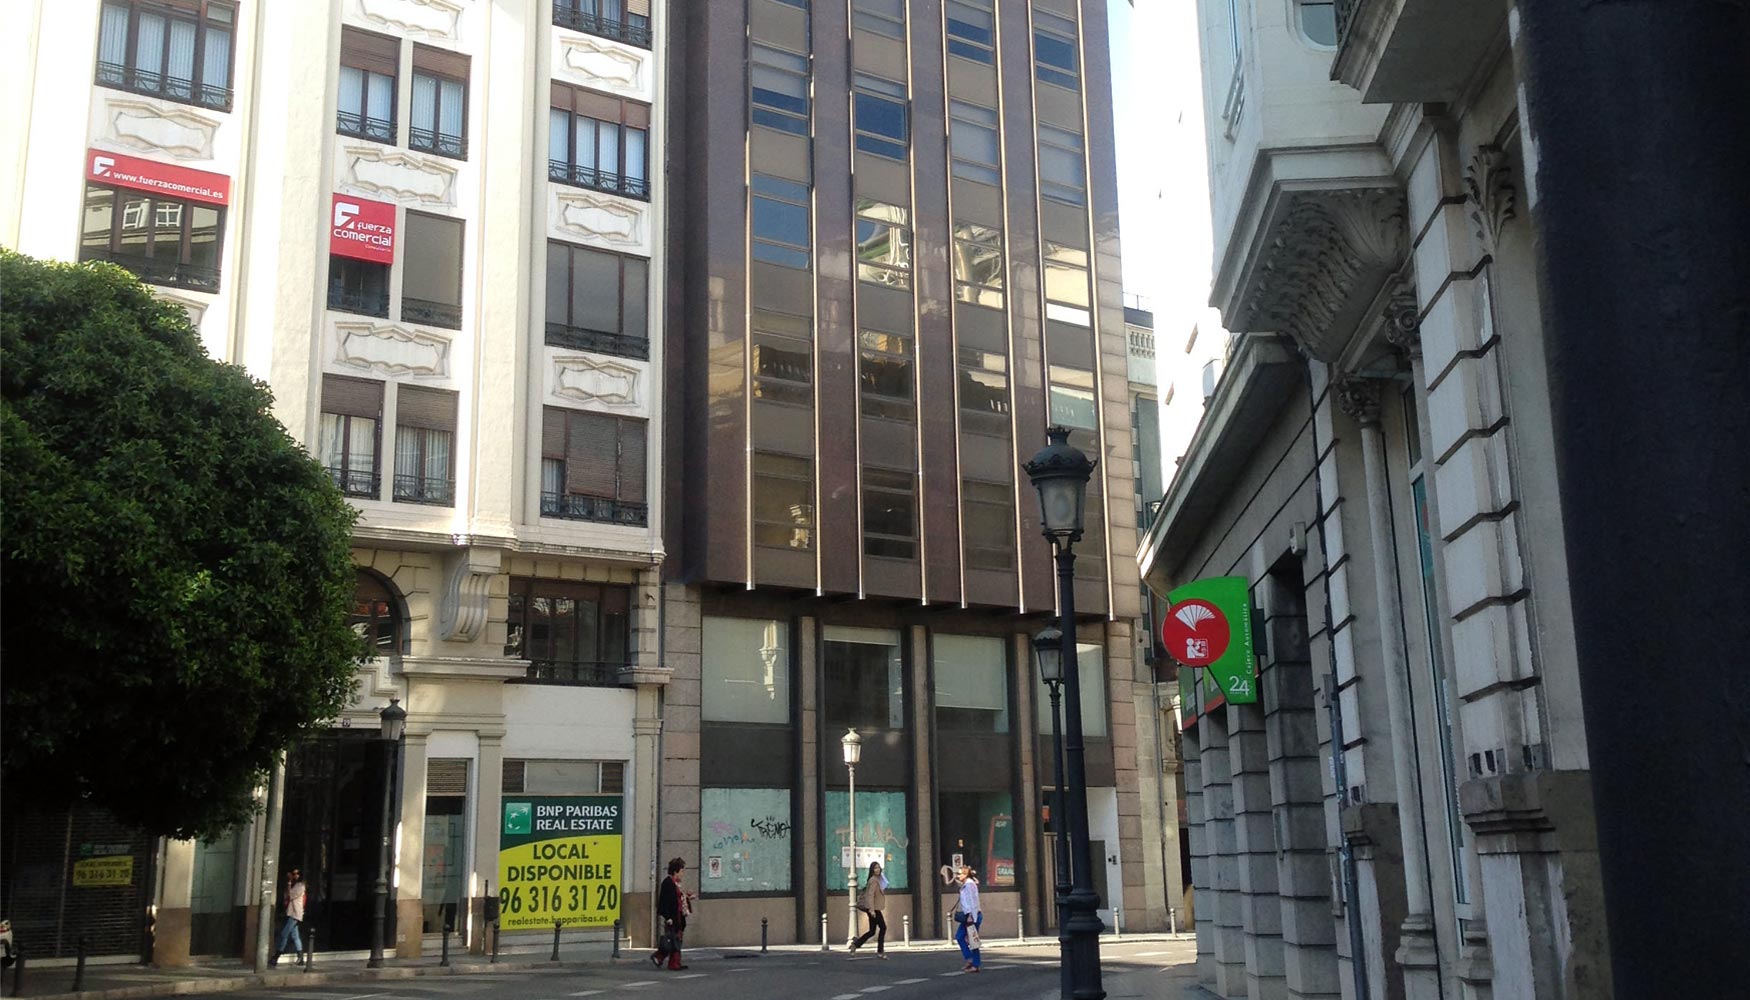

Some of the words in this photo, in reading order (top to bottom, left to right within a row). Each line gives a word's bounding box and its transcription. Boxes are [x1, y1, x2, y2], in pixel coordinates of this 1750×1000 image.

[113, 171, 223, 199] www.fuerzacomercial.es
[357, 222, 392, 234] fuerza
[333, 228, 392, 247] comercial
[1229, 675, 1250, 697] 24
[536, 806, 564, 817] BNP
[566, 805, 618, 817] PARIBAS
[536, 819, 568, 830] REAL
[570, 819, 614, 830] ESTATE
[533, 843, 589, 860] LOCAL
[507, 864, 612, 881] DISPONIBLE
[499, 886, 522, 914] 96
[528, 885, 562, 912] 316
[568, 884, 588, 911] 31
[596, 884, 618, 910] 20
